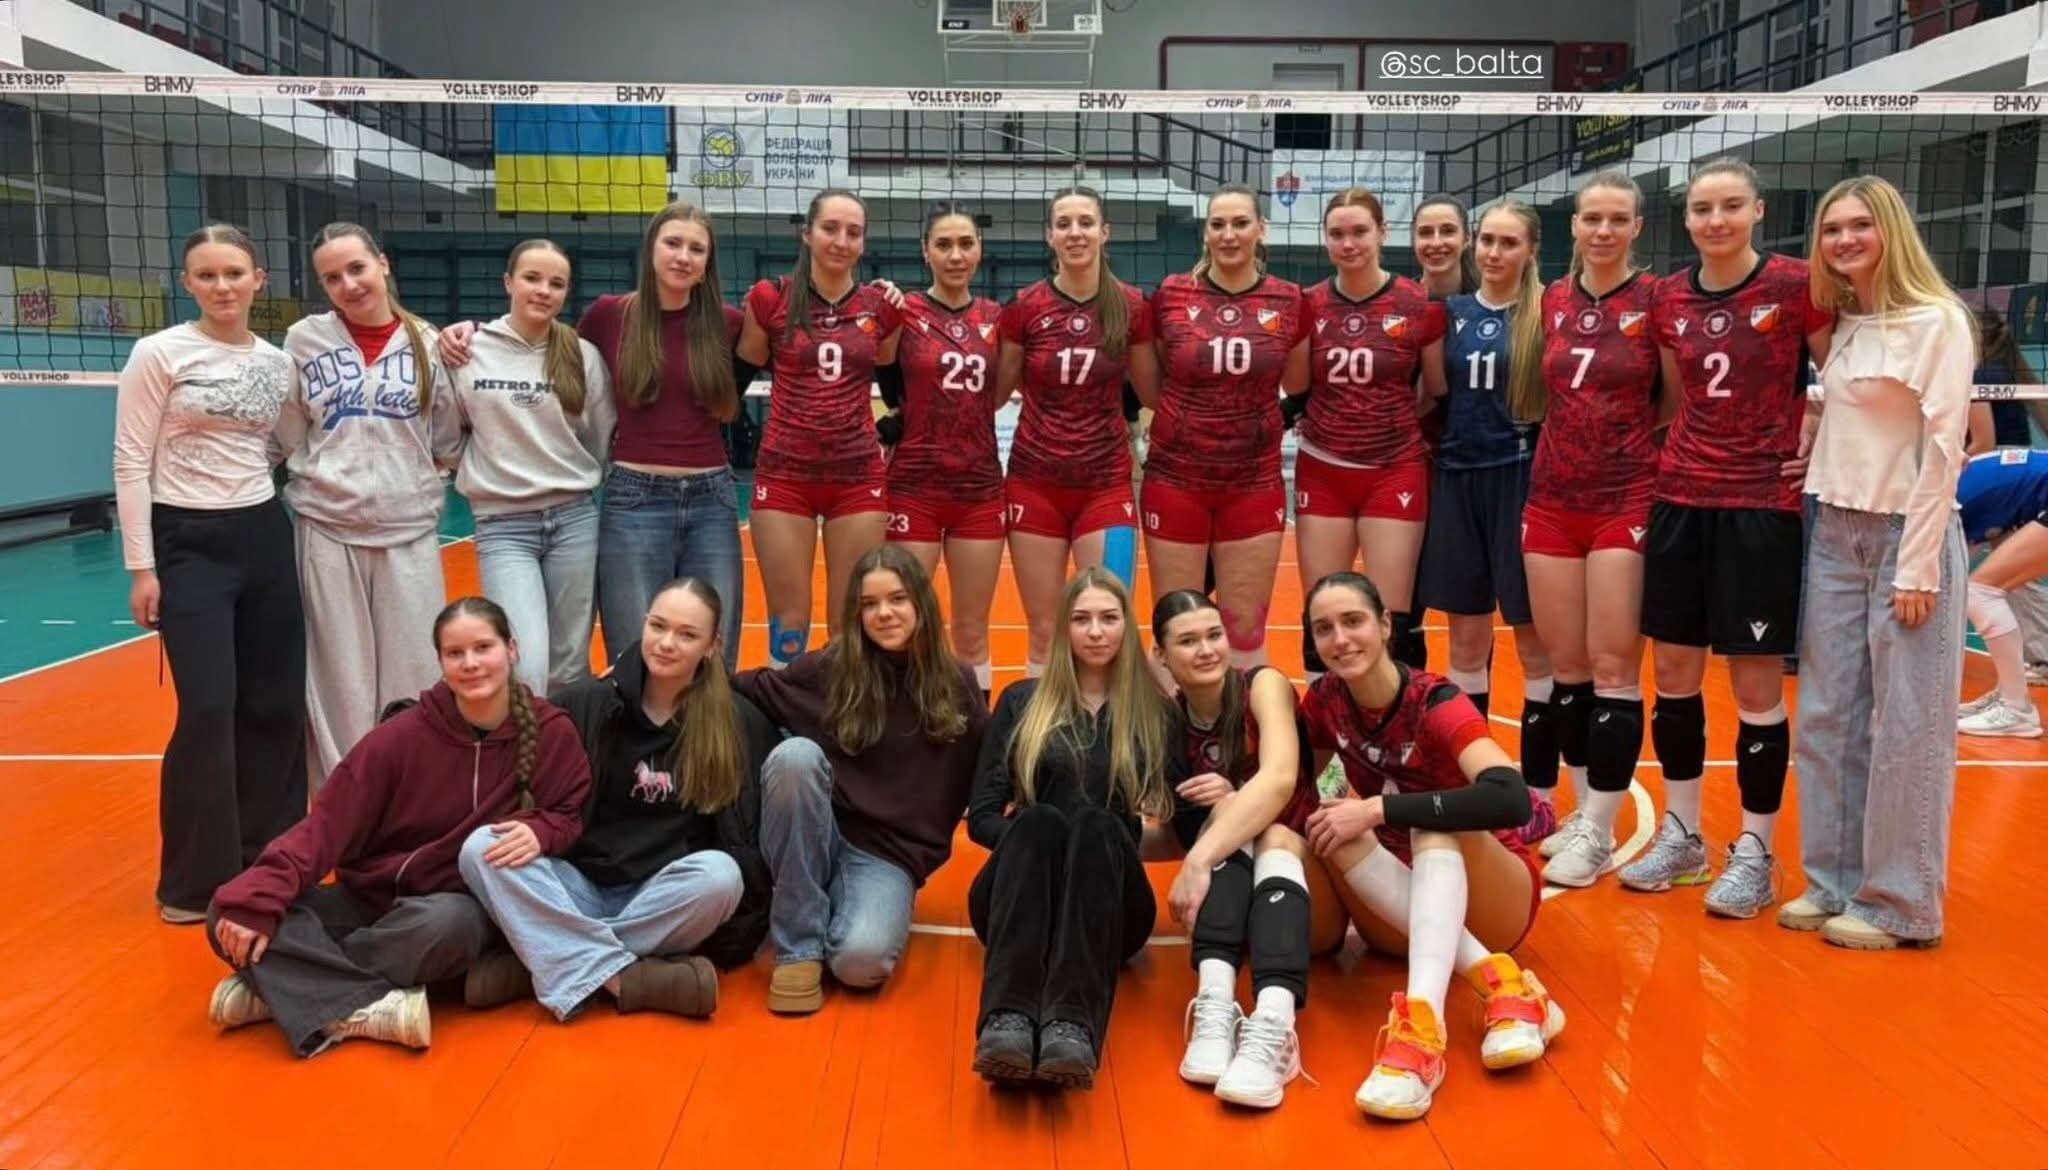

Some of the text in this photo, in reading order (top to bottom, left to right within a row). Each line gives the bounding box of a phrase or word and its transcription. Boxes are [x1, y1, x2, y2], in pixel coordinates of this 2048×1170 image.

[144, 75, 194, 93] ВНМУ
[442, 83, 539, 96] VOLLEYSHOP
[616, 86, 666, 102] ВНМУ
[908, 90, 1003, 104] VOLLEYSHOP
[1079, 92, 1128, 110] ВНМУ
[1367, 95, 1462, 108] VOLLEYSHOP
[1824, 95, 1919, 108] VOLLEYSHOP
[1536, 95, 1584, 113] ВНМУ
[1993, 95, 2042, 113] ВНМУ
[766, 169, 816, 180] УКРАНИ
[817, 341, 843, 382] 9
[1207, 337, 1252, 375] 10
[302, 346, 417, 400] BOSTO
[940, 351, 987, 393] 23
[1056, 346, 1097, 386] 17
[1326, 347, 1374, 384] 20
[1466, 351, 1496, 390] 11
[1569, 348, 1595, 389] 7
[1, 372, 70, 380] VOLLEYSHOP
[1703, 352, 1732, 398] 2
[473, 379, 552, 393] METRO M
[886, 512, 910, 533] 23
[1006, 503, 1025, 524] 17
[1145, 511, 1160, 530] 10
